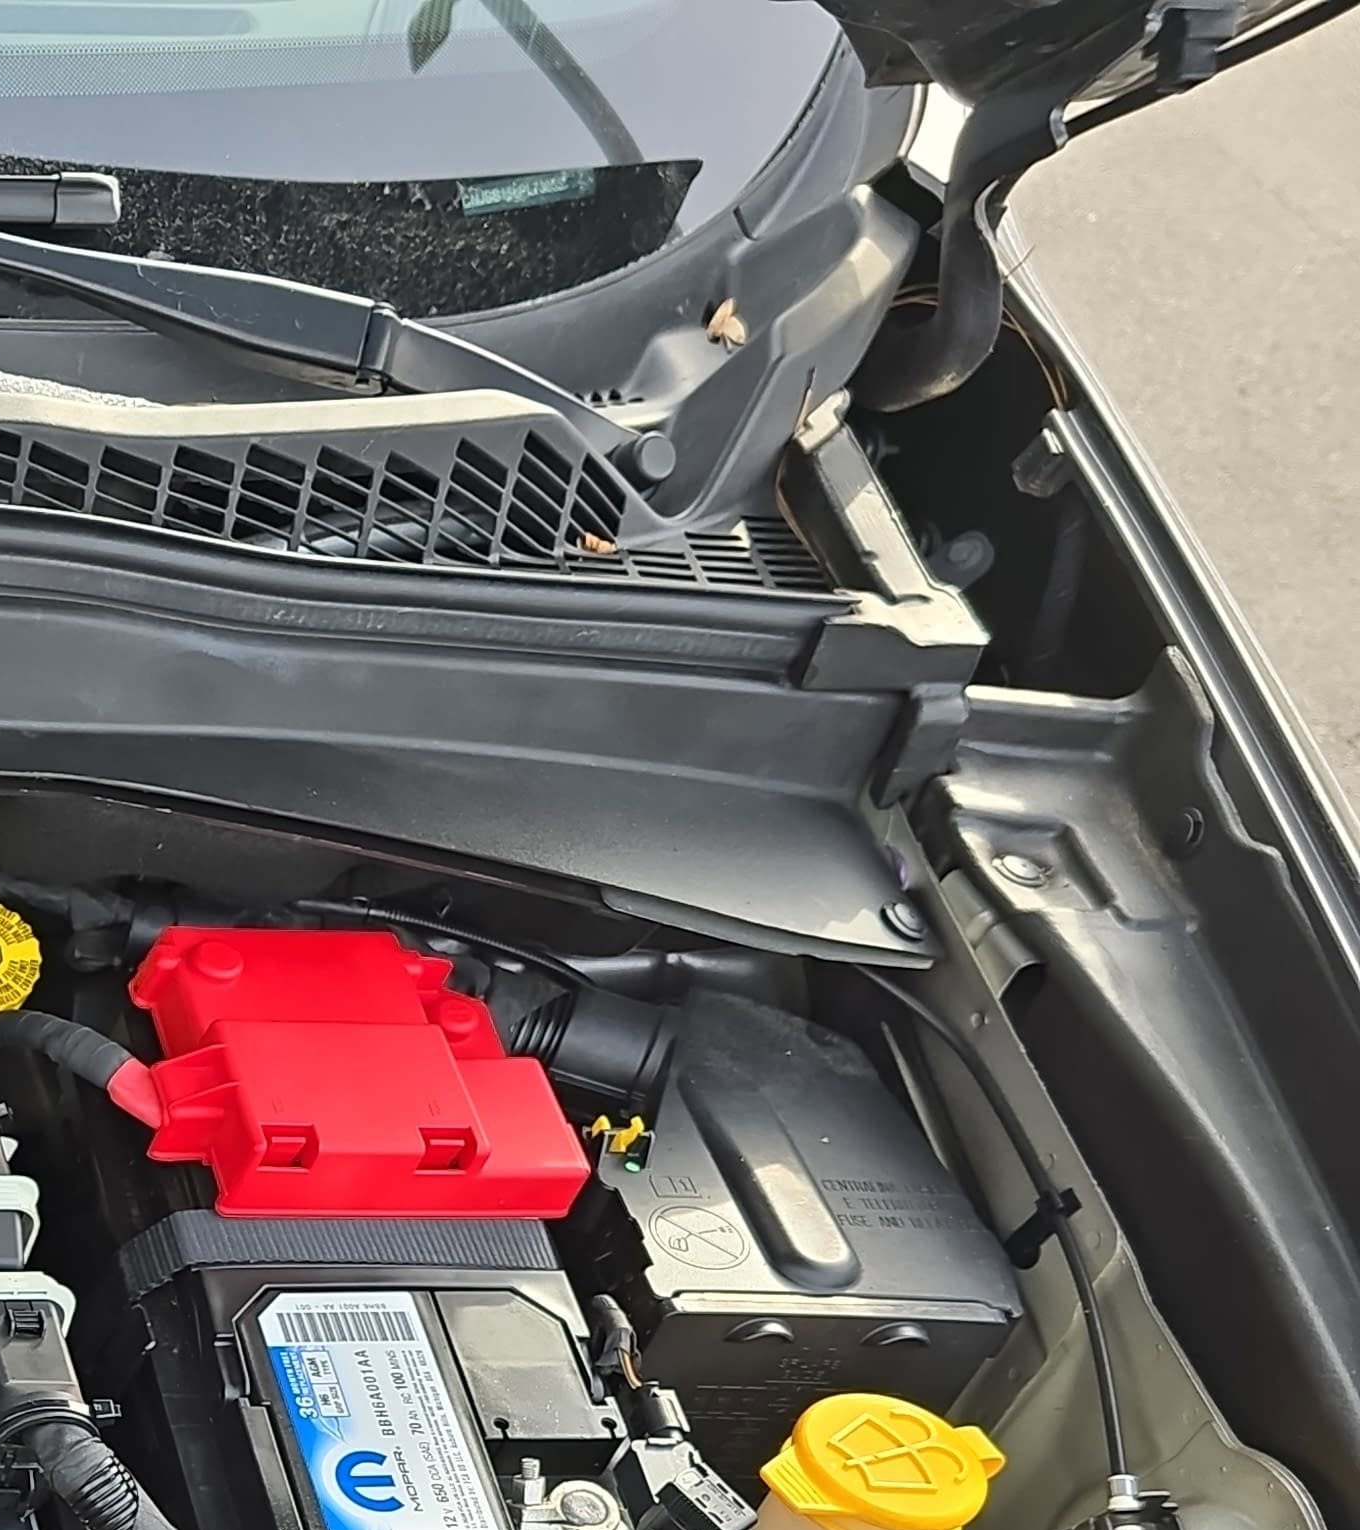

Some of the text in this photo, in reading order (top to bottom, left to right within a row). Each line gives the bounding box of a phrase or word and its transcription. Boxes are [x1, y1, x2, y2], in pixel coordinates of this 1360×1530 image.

[305, 1356, 322, 1378] AGM
[389, 1371, 408, 1390] 100
[352, 1348, 396, 1436] BBH6A001AA
[293, 1394, 319, 1418] 36
[407, 1421, 425, 1435] 70
[430, 1483, 450, 1502] 650
